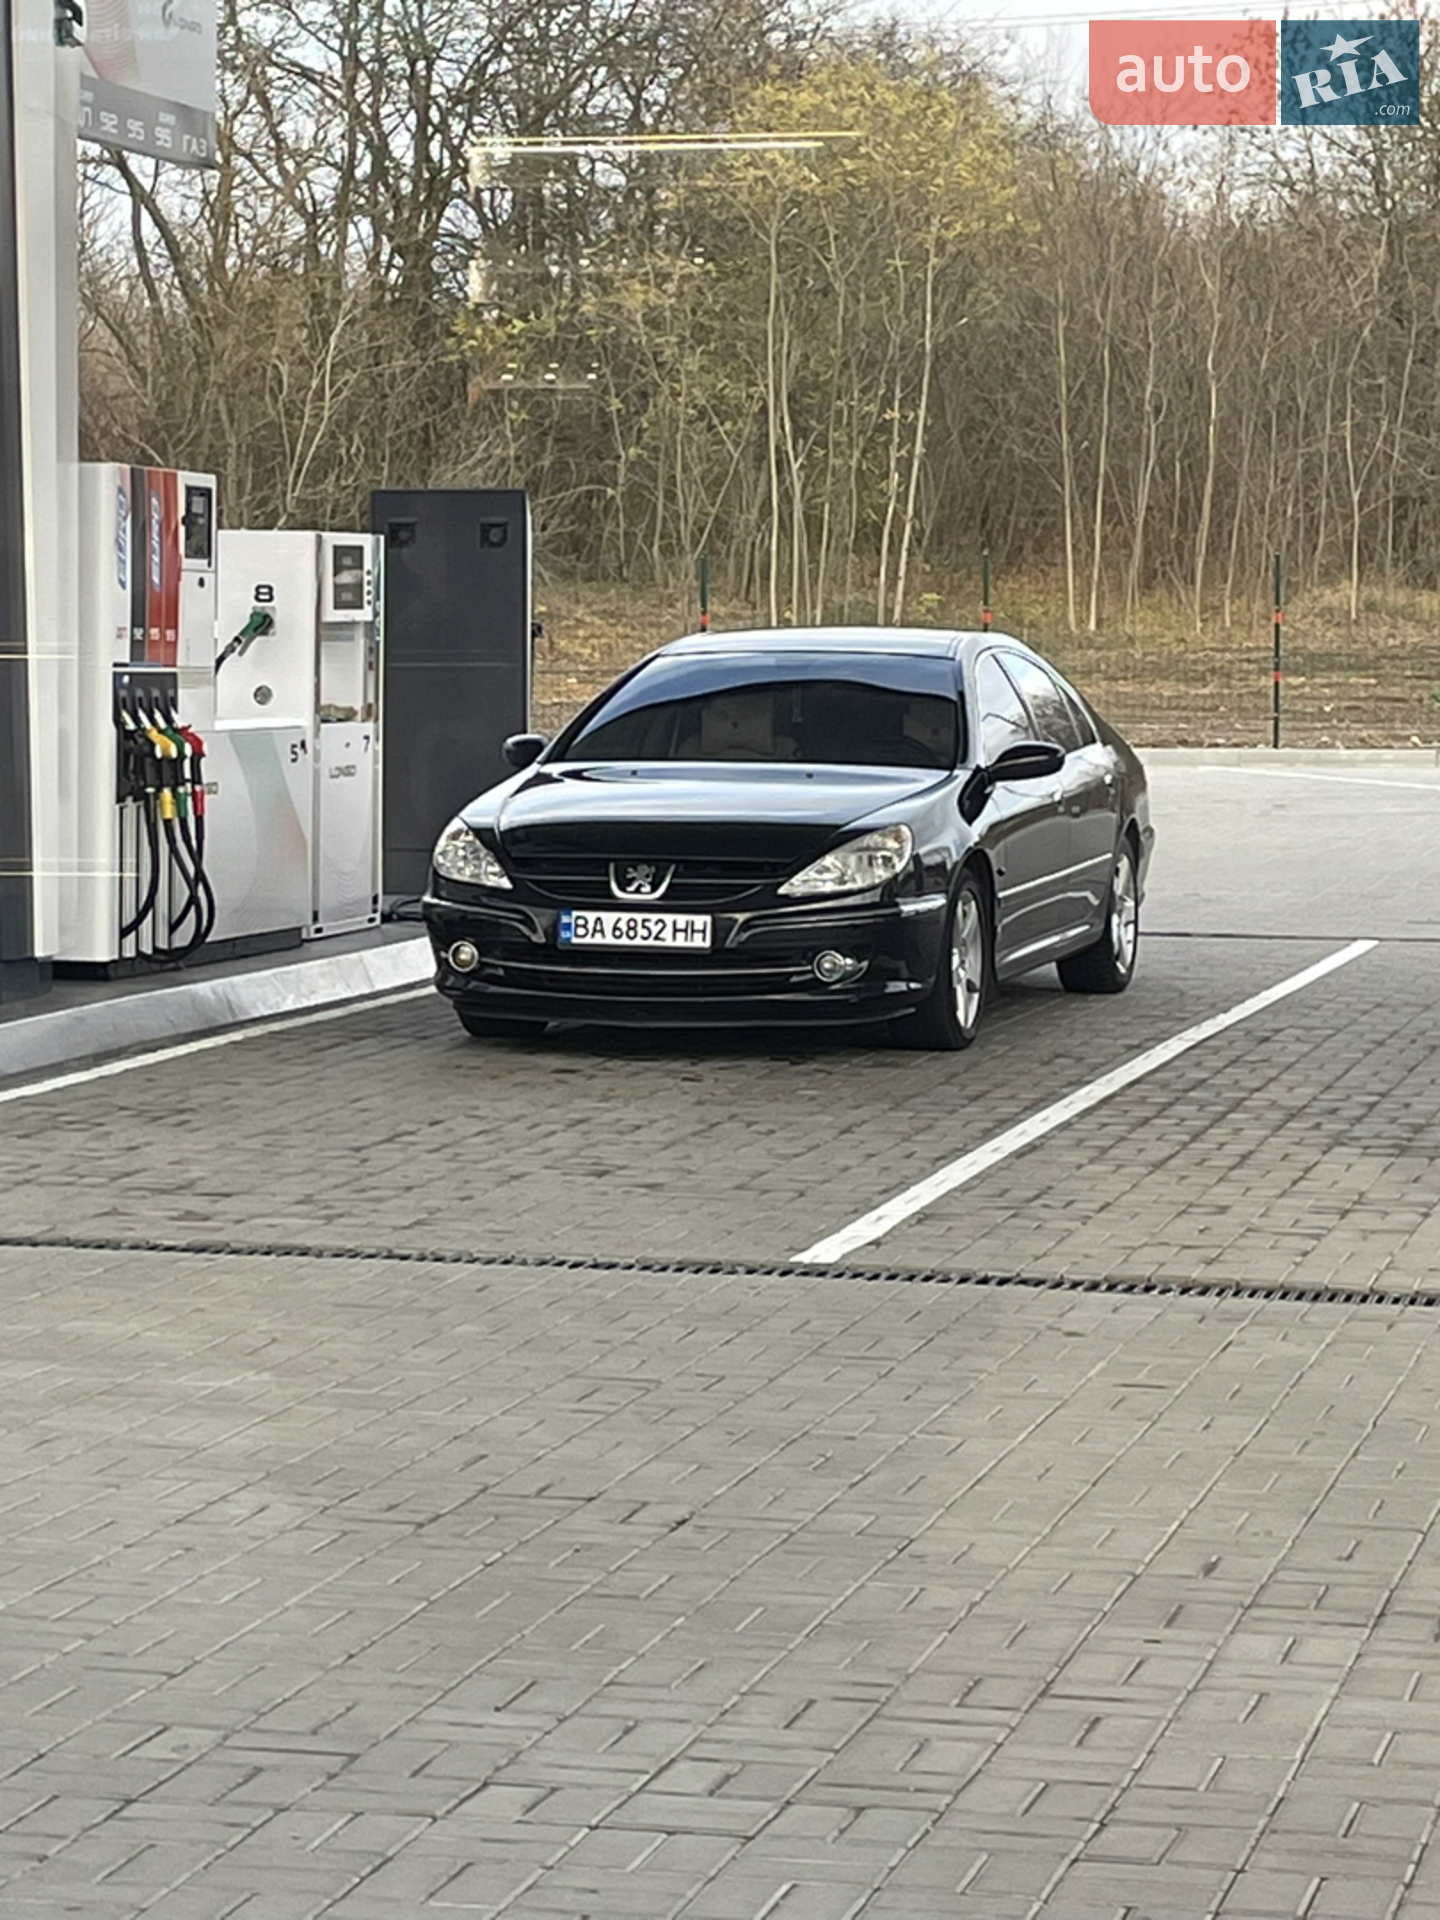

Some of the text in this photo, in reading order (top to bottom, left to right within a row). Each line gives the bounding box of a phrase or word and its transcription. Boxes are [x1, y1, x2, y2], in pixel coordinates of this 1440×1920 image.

[99, 111, 119, 134] 92
[126, 118, 145, 141] 95
[182, 134, 208, 157] ГАЗ
[254, 584, 275, 603] 8
[290, 743, 299, 763] 5
[362, 734, 371, 754] 7
[573, 915, 707, 943] BA 6852 HH
